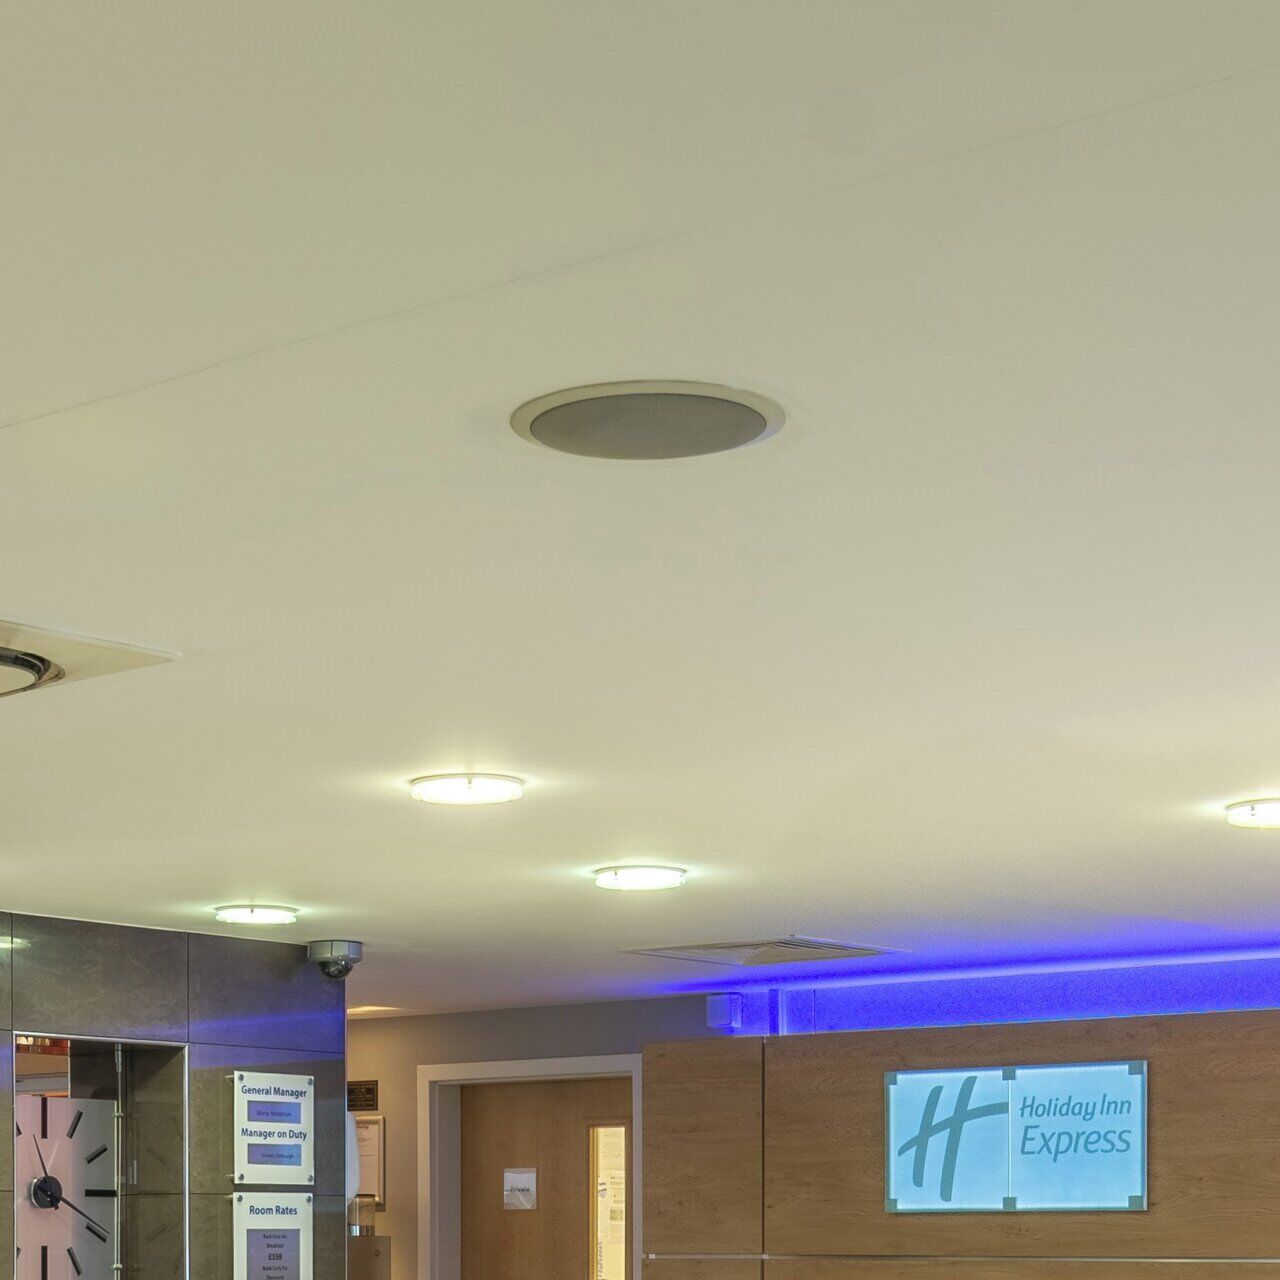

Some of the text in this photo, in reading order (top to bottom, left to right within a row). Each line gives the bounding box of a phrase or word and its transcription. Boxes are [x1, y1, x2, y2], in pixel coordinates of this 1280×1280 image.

[241, 1085, 307, 1099] General Manager
[1020, 1093, 1132, 1122] Holiday Inn
[241, 1127, 276, 1139] Manager
[288, 1130, 307, 1141] Duty
[1020, 1124, 1132, 1163] Express
[249, 1205, 298, 1215] Room Rates
